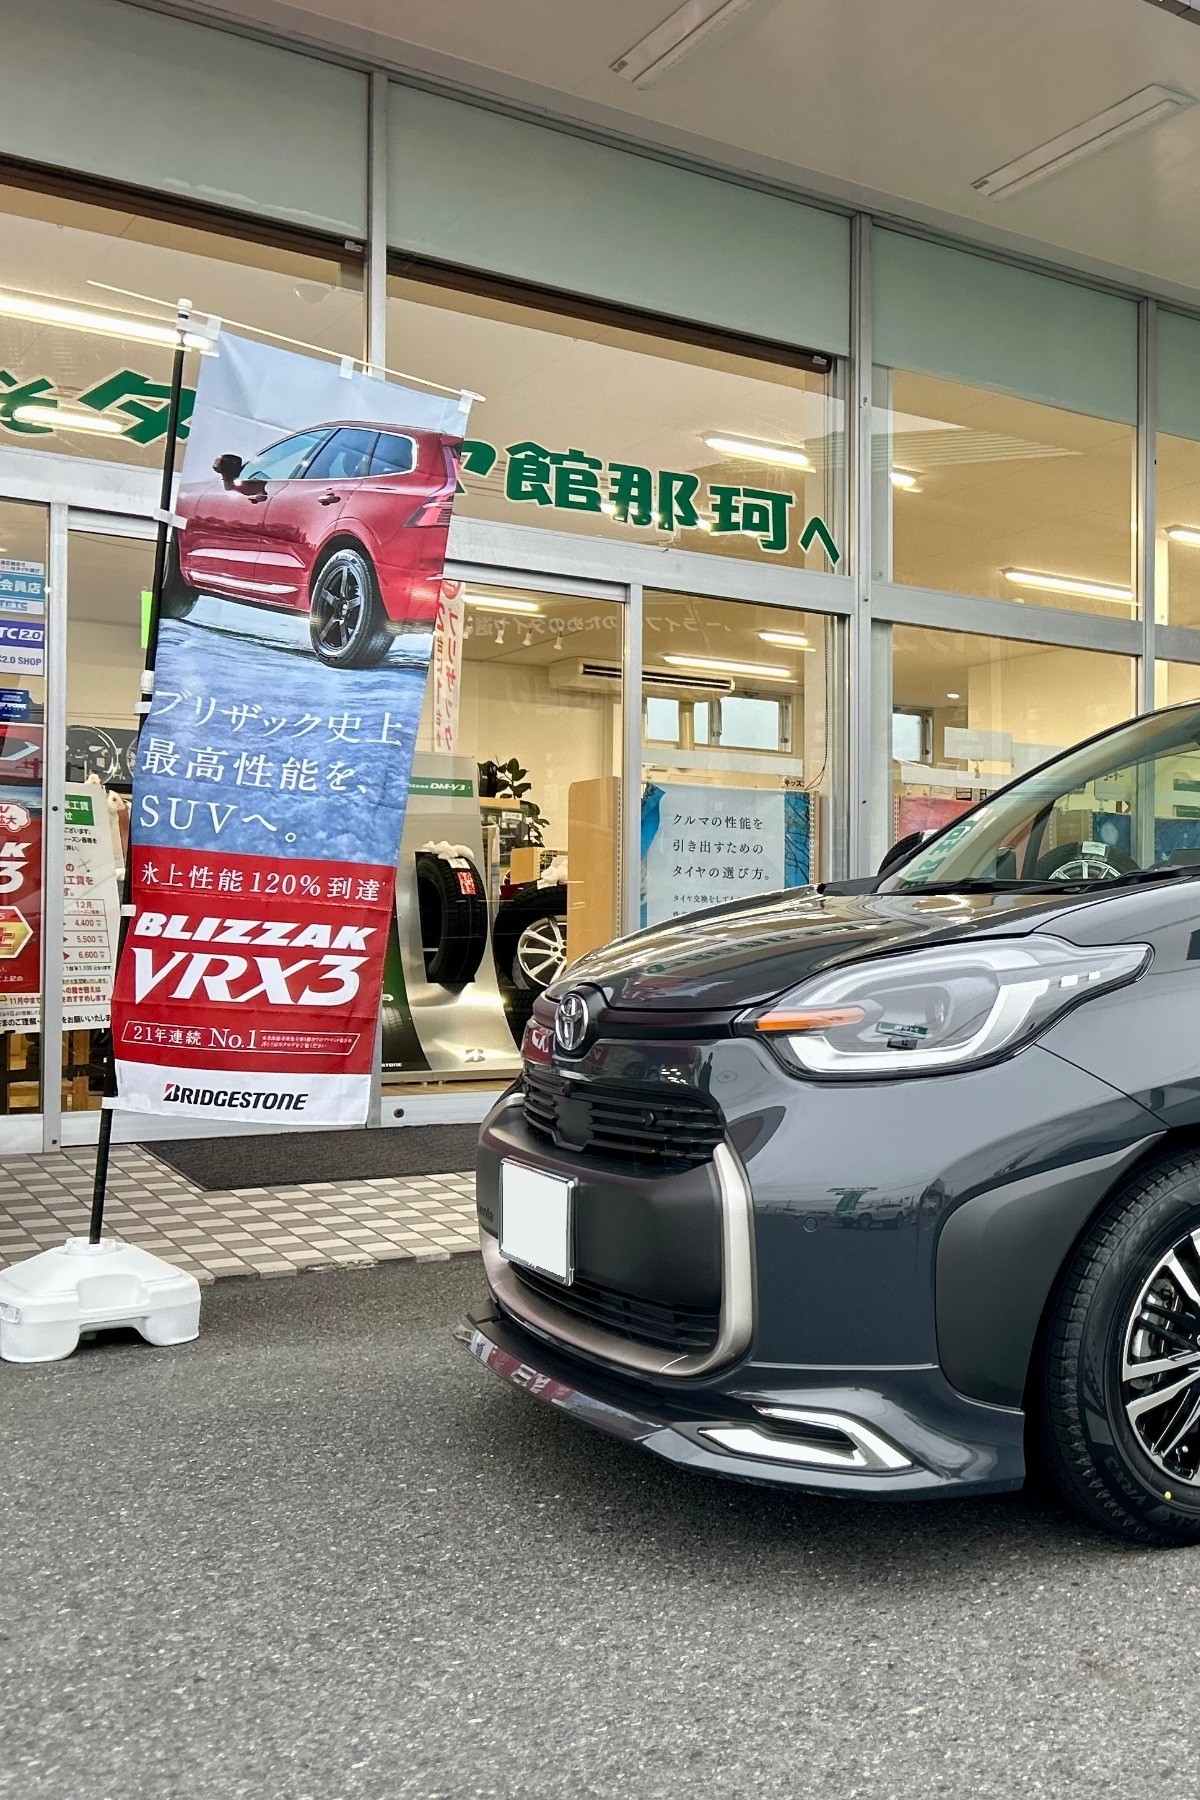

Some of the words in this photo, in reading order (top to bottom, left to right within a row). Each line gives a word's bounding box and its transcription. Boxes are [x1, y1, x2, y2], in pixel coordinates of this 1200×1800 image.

[18, 656, 42, 666] SHOP
[152, 690, 403, 746] ブリザック史上
[141, 737, 367, 793] 最高性能を、
[140, 795, 297, 843] SUVへ。
[672, 813, 763, 830] クルマの性能を
[672, 839, 763, 855] 引き出すための
[64, 876, 94, 885] 工賃を
[672, 866, 771, 881] タイヤの選び方。
[133, 911, 378, 950] BLIZZAK
[131, 948, 371, 1006] VRX3
[133, 1026, 202, 1046] 21年連続
[208, 1028, 257, 1049] No.1
[163, 1084, 308, 1110] BRIDGESTONE
